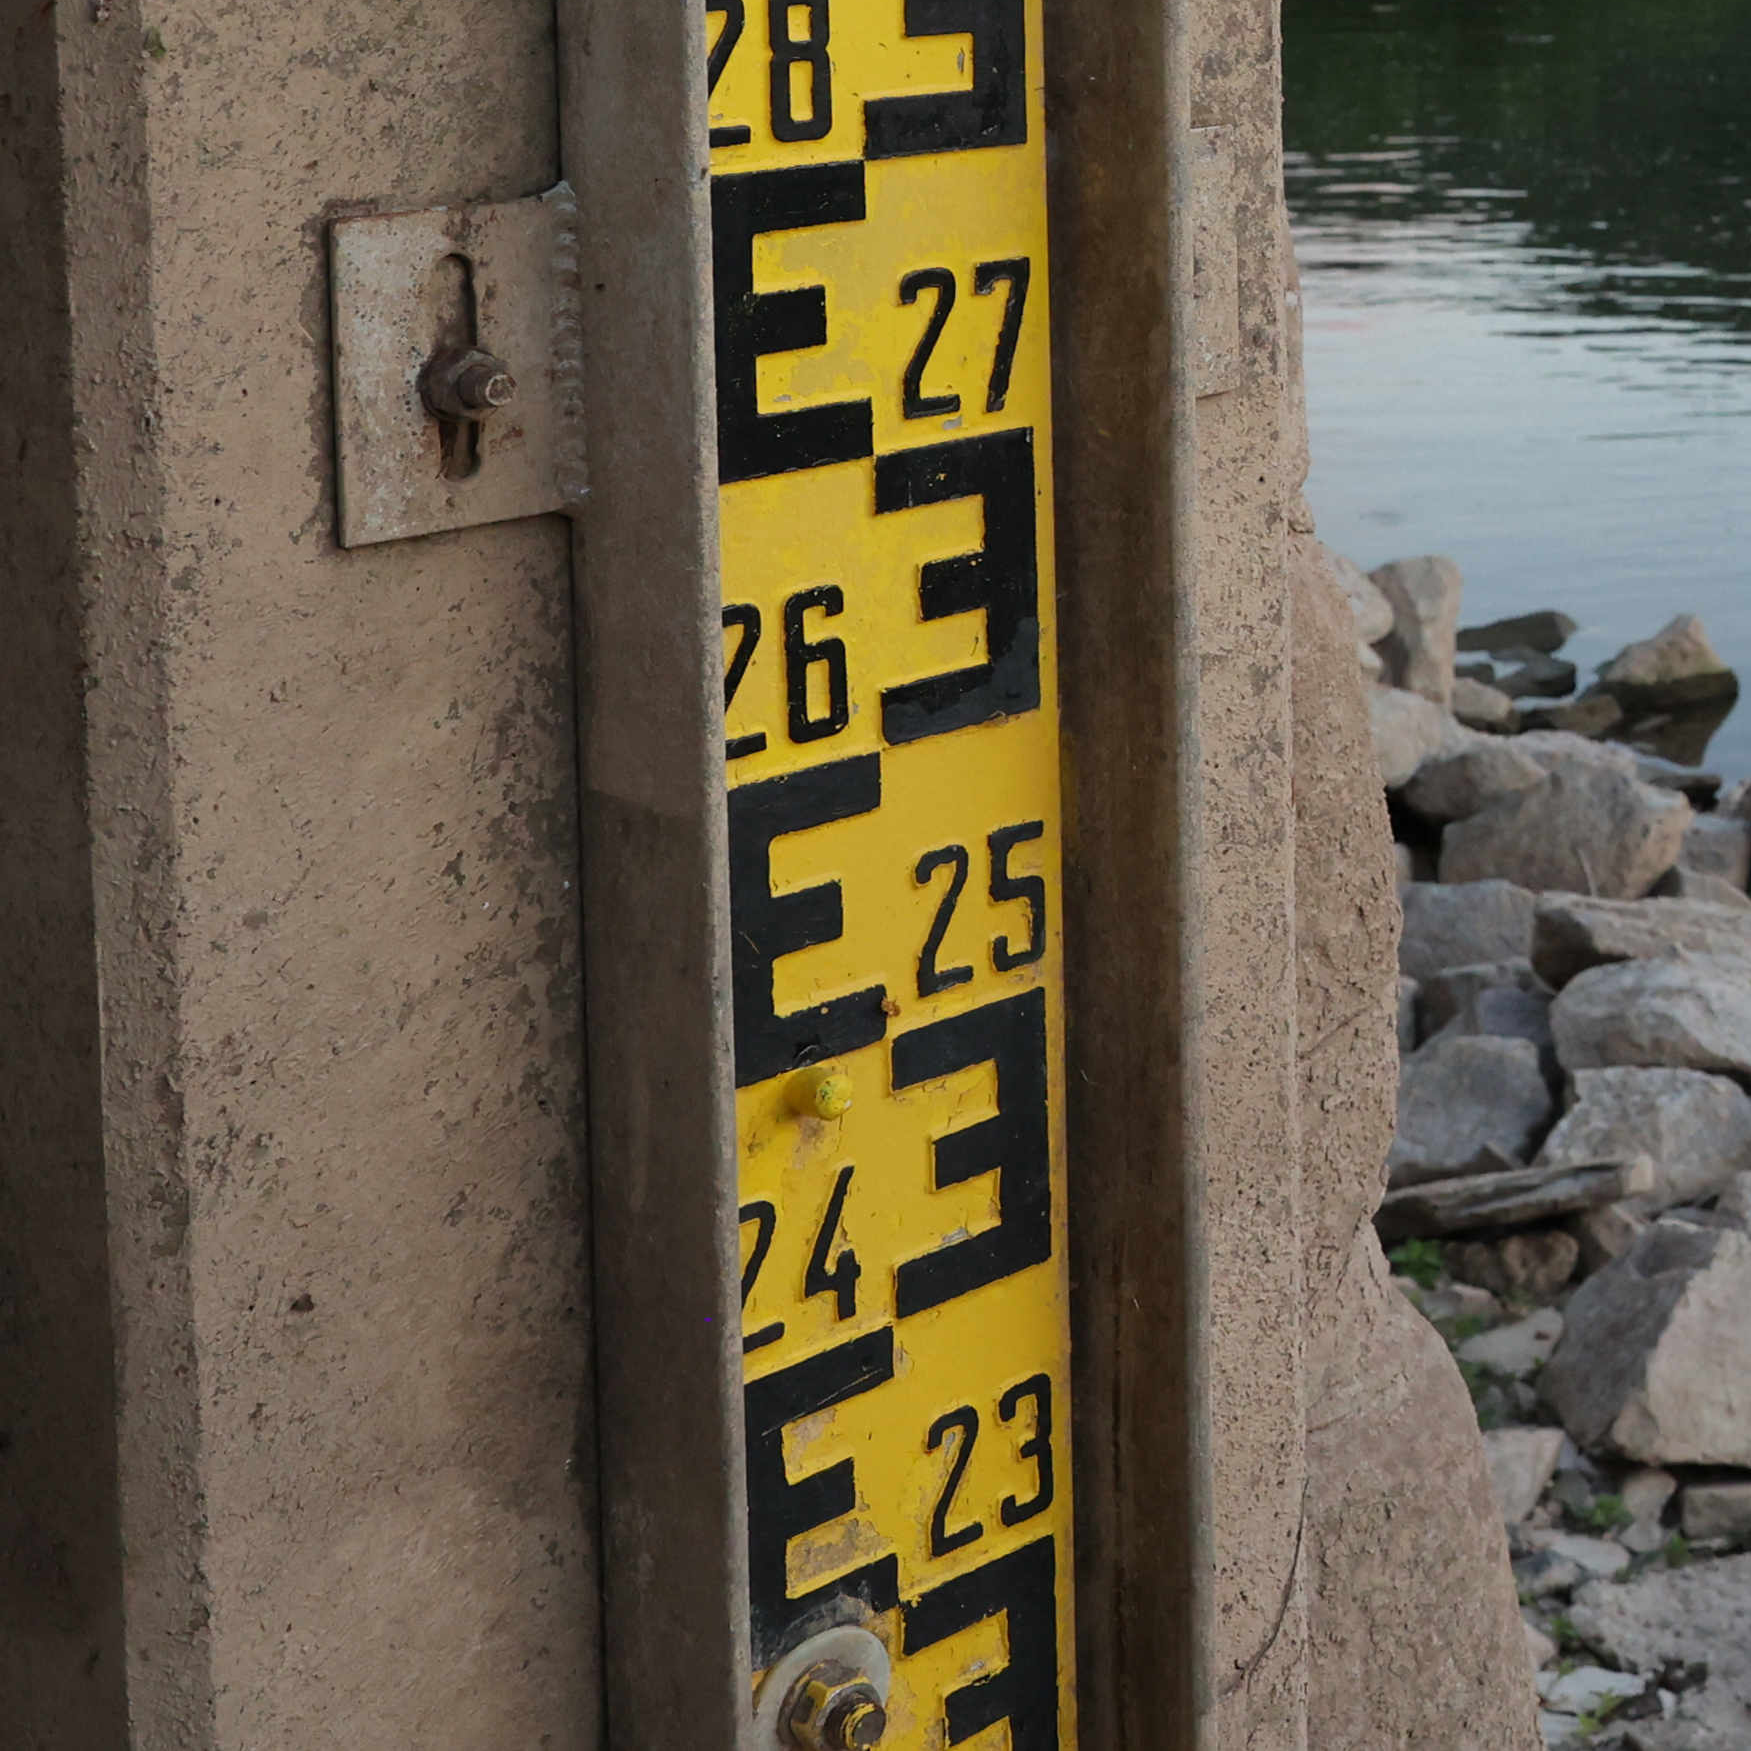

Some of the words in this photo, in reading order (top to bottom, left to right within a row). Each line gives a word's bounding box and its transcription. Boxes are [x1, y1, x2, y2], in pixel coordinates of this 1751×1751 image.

[899, 256, 1031, 421] 27
[721, 583, 850, 759] 26
[914, 819, 1046, 999] 25
[738, 1165, 861, 1351] 24
[926, 1372, 1055, 1558] 23
